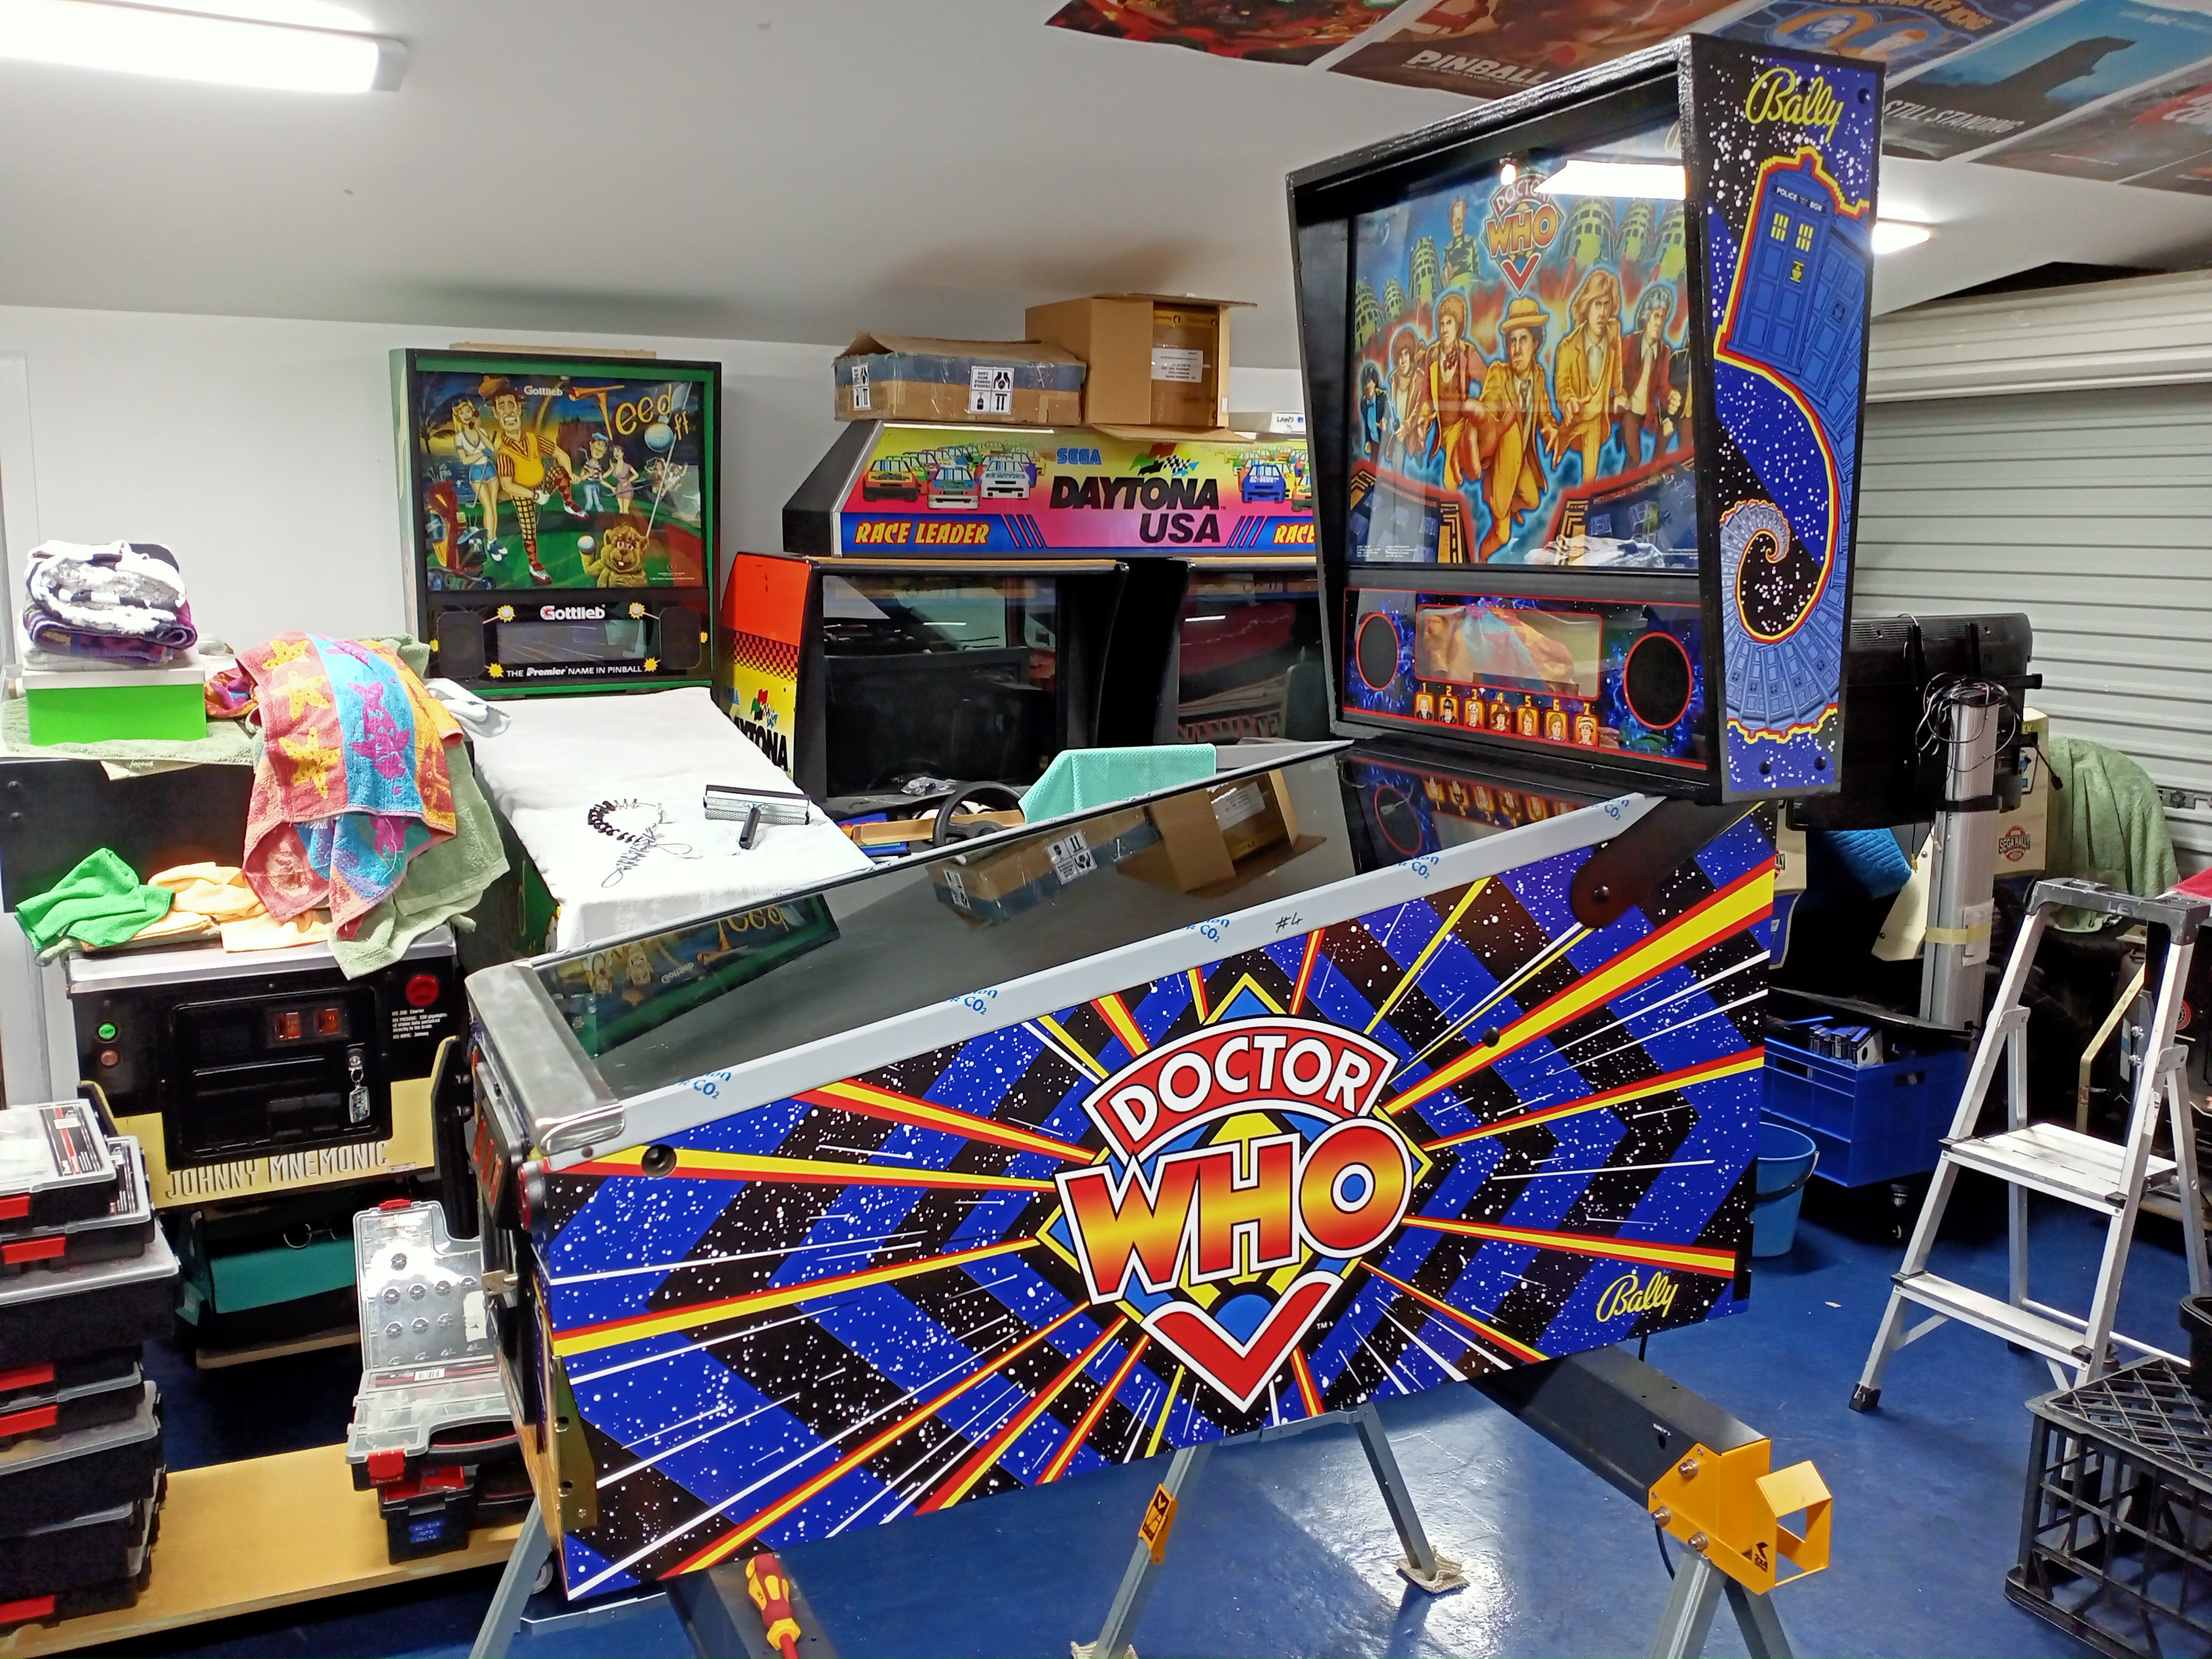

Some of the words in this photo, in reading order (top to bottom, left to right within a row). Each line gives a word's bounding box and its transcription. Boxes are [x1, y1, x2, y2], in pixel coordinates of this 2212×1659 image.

[1406, 49, 1550, 85] PINBALL
[1745, 66, 1844, 143] Bally
[1884, 100, 1937, 121] STILL
[1923, 109, 2025, 134] STANDING
[1776, 186, 1798, 201] POLICE
[1809, 200, 1823, 212] BOX
[1485, 204, 1558, 258] WHO
[523, 385, 564, 397] Gottlieb
[1056, 448, 1102, 465] SEGA
[1049, 476, 1220, 510] DAYTONA
[855, 521, 911, 544] RACE
[915, 523, 990, 544] LEADER
[1139, 513, 1220, 544] USA
[1273, 524, 1314, 544] RACE
[540, 604, 606, 620] Gottlieb
[506, 670, 524, 678] THE
[526, 667, 566, 677] Premier
[567, 667, 594, 675] NAME
[607, 665, 643, 674] PINBALL
[1422, 682, 1427, 693] 1
[1446, 685, 1452, 696] 2
[1472, 688, 1478, 700] 3
[1496, 692, 1504, 703] 4
[1525, 695, 1532, 707] 5
[1552, 698, 1559, 711] 6
[1583, 703, 1590, 715] 7
[1999, 838, 2014, 853] SEGA
[2015, 835, 2030, 849] RALLY
[1199, 925, 1220, 943] CO2
[1275, 912, 1303, 934] #4
[964, 996, 988, 1015] CO2
[692, 1079, 721, 1100] CO2
[1108, 1034, 1373, 1144] DOCTOR
[166, 1159, 258, 1199] JOHNNY
[268, 1140, 389, 1184] MNEMONIC
[1054, 1115, 1414, 1306] WHO
[1595, 1270, 1679, 1323] Bally
